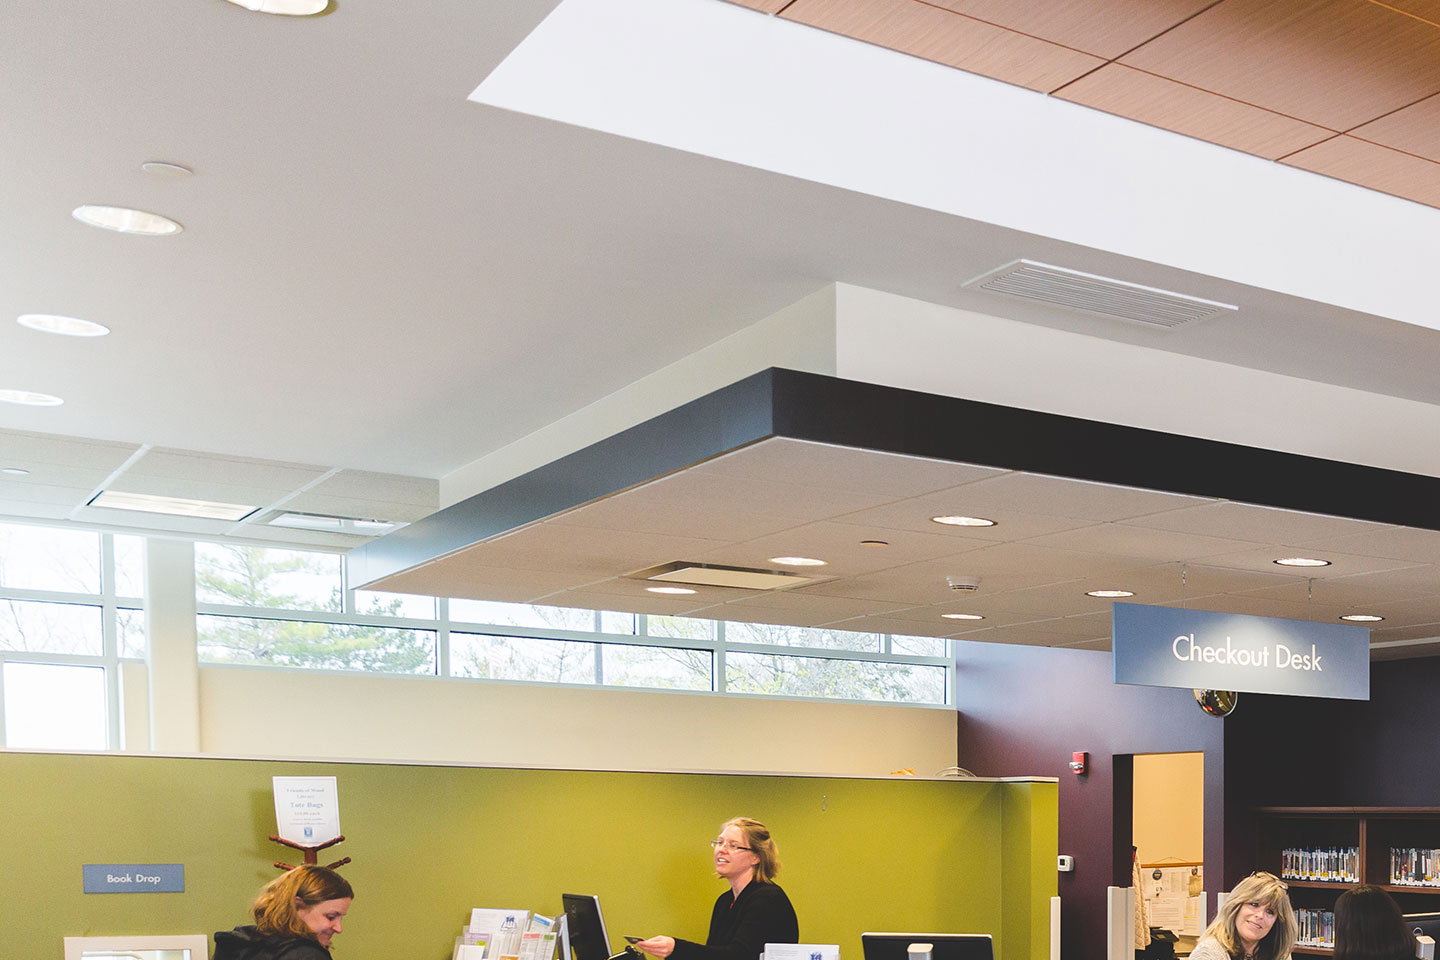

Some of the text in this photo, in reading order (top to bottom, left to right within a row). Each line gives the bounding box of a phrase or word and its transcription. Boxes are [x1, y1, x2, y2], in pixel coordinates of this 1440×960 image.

[1172, 633, 1323, 672] Checkout Desk
[106, 873, 161, 885] Book Drop
